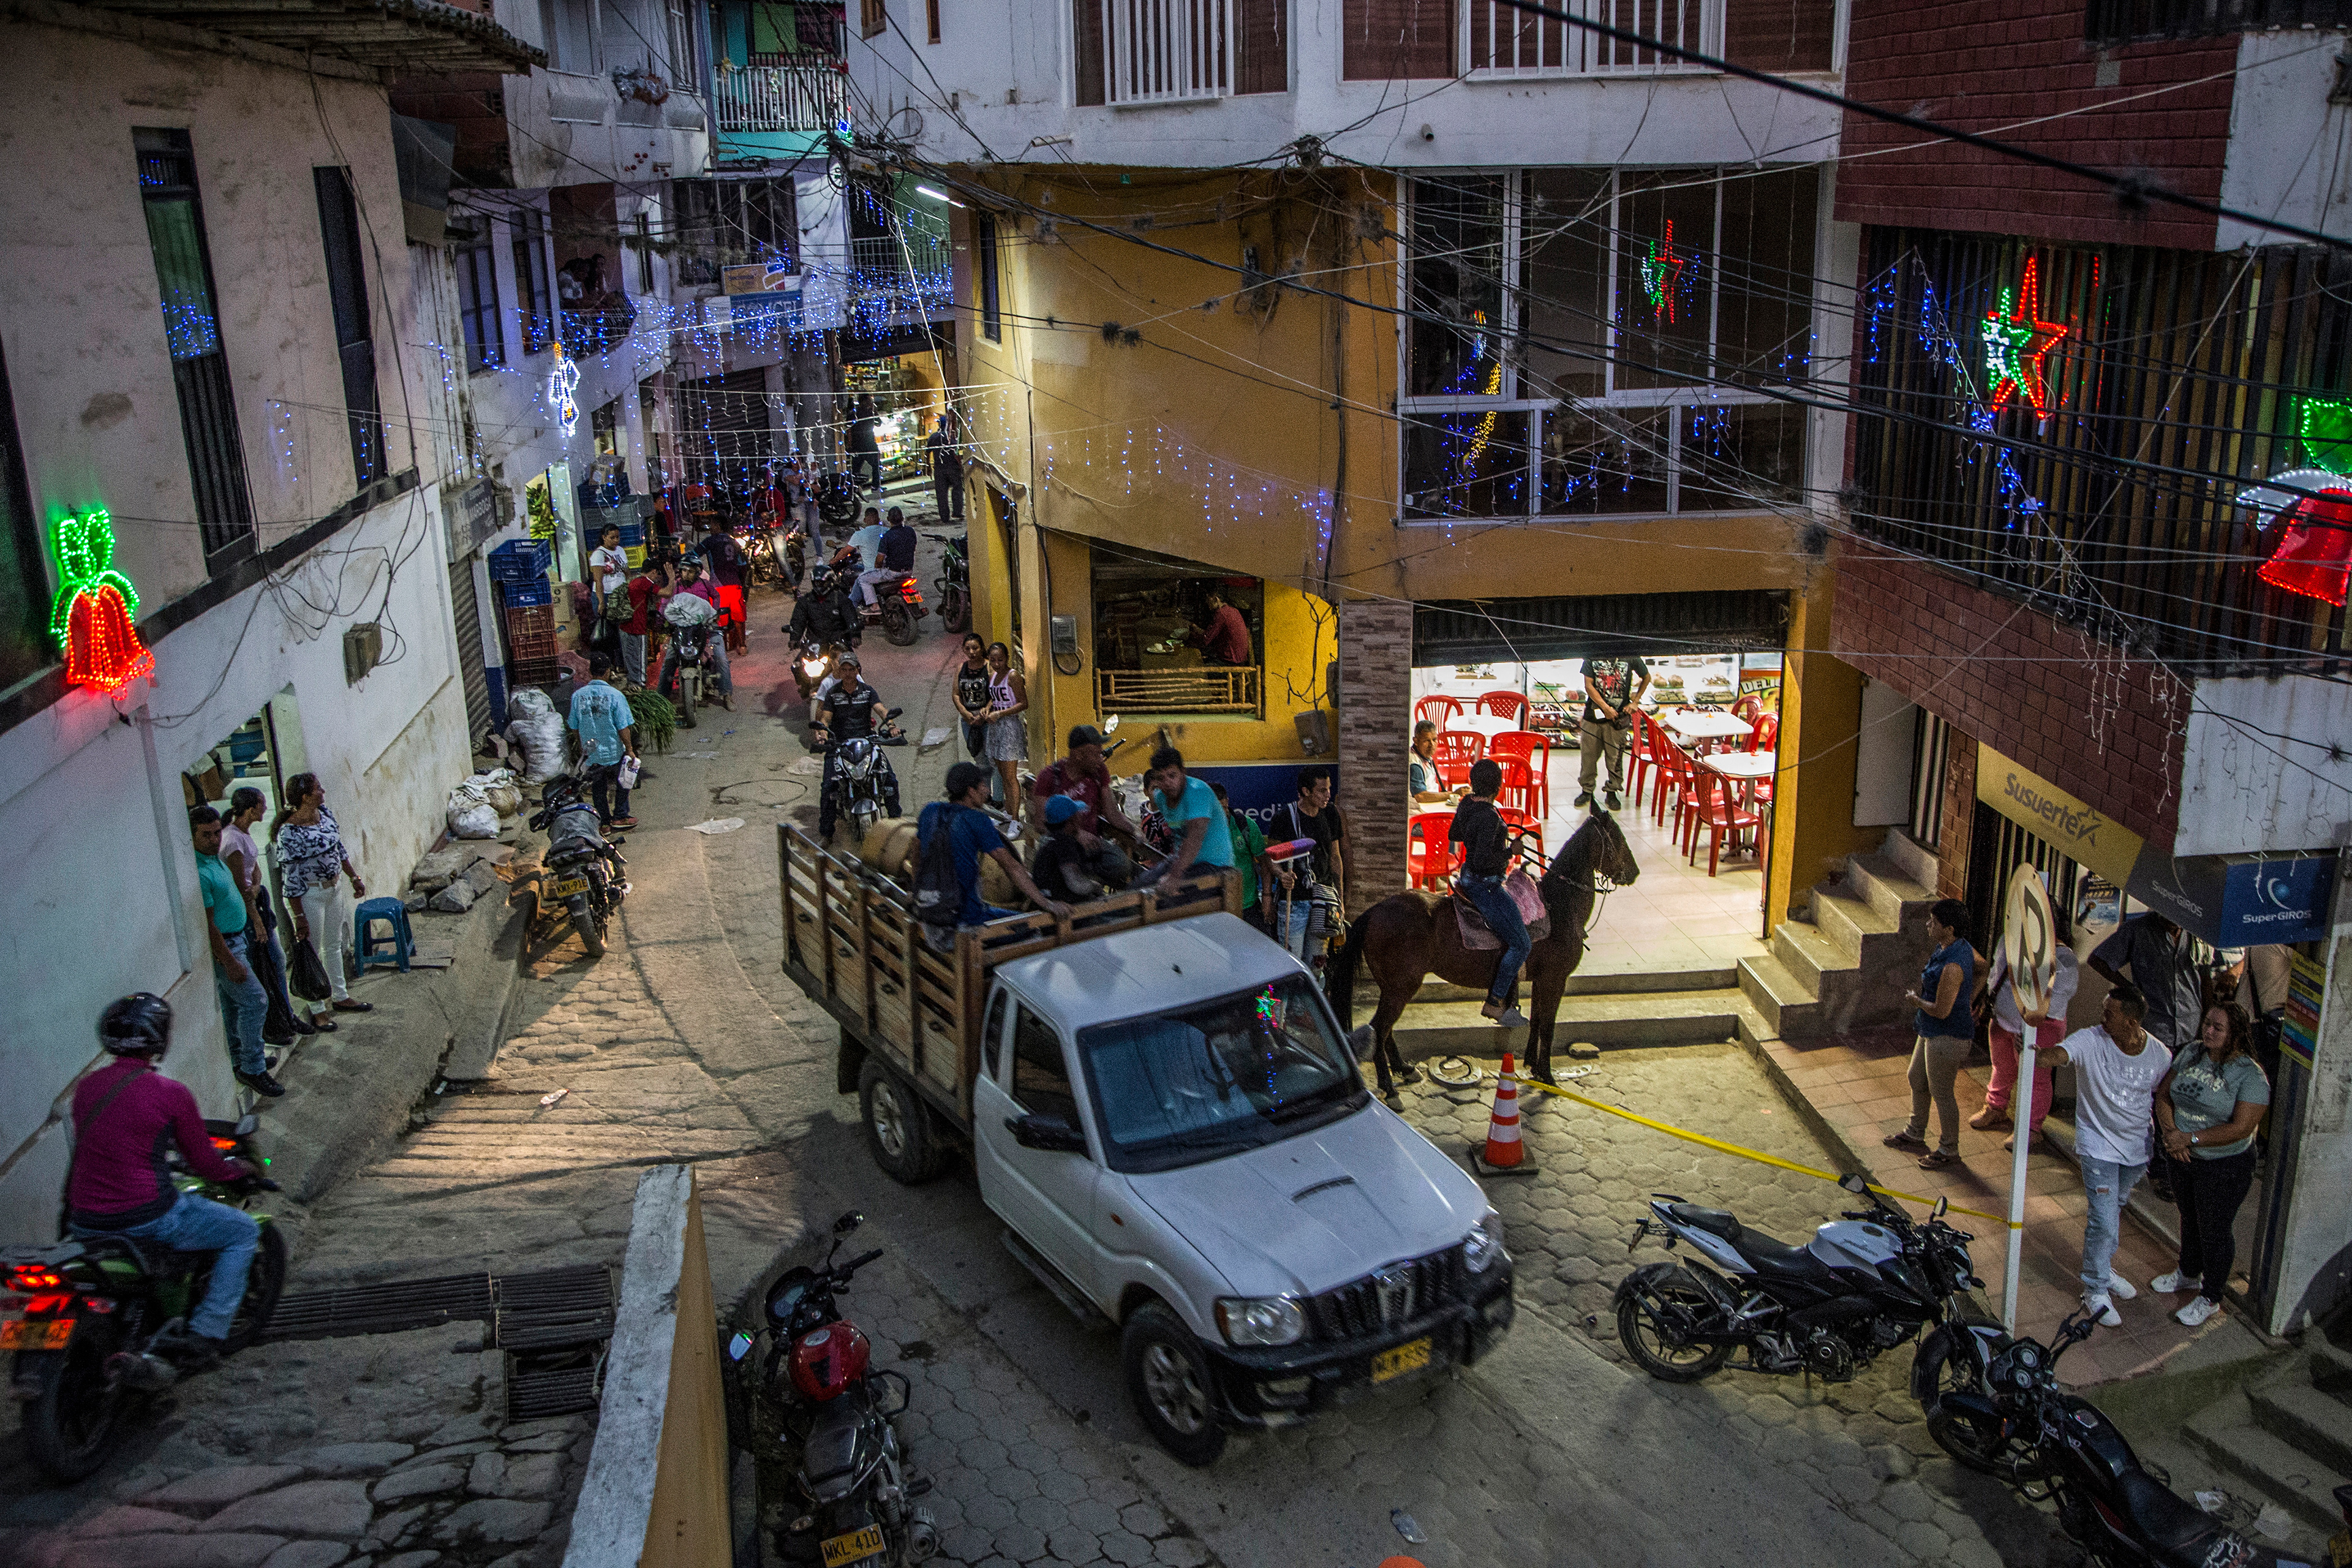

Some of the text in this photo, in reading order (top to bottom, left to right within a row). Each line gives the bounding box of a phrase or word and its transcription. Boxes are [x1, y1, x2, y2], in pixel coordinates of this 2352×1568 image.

[724, 543, 735, 562] 9
[2004, 772, 2079, 837] Susuerte
[824, 1540, 851, 1561] MKL
